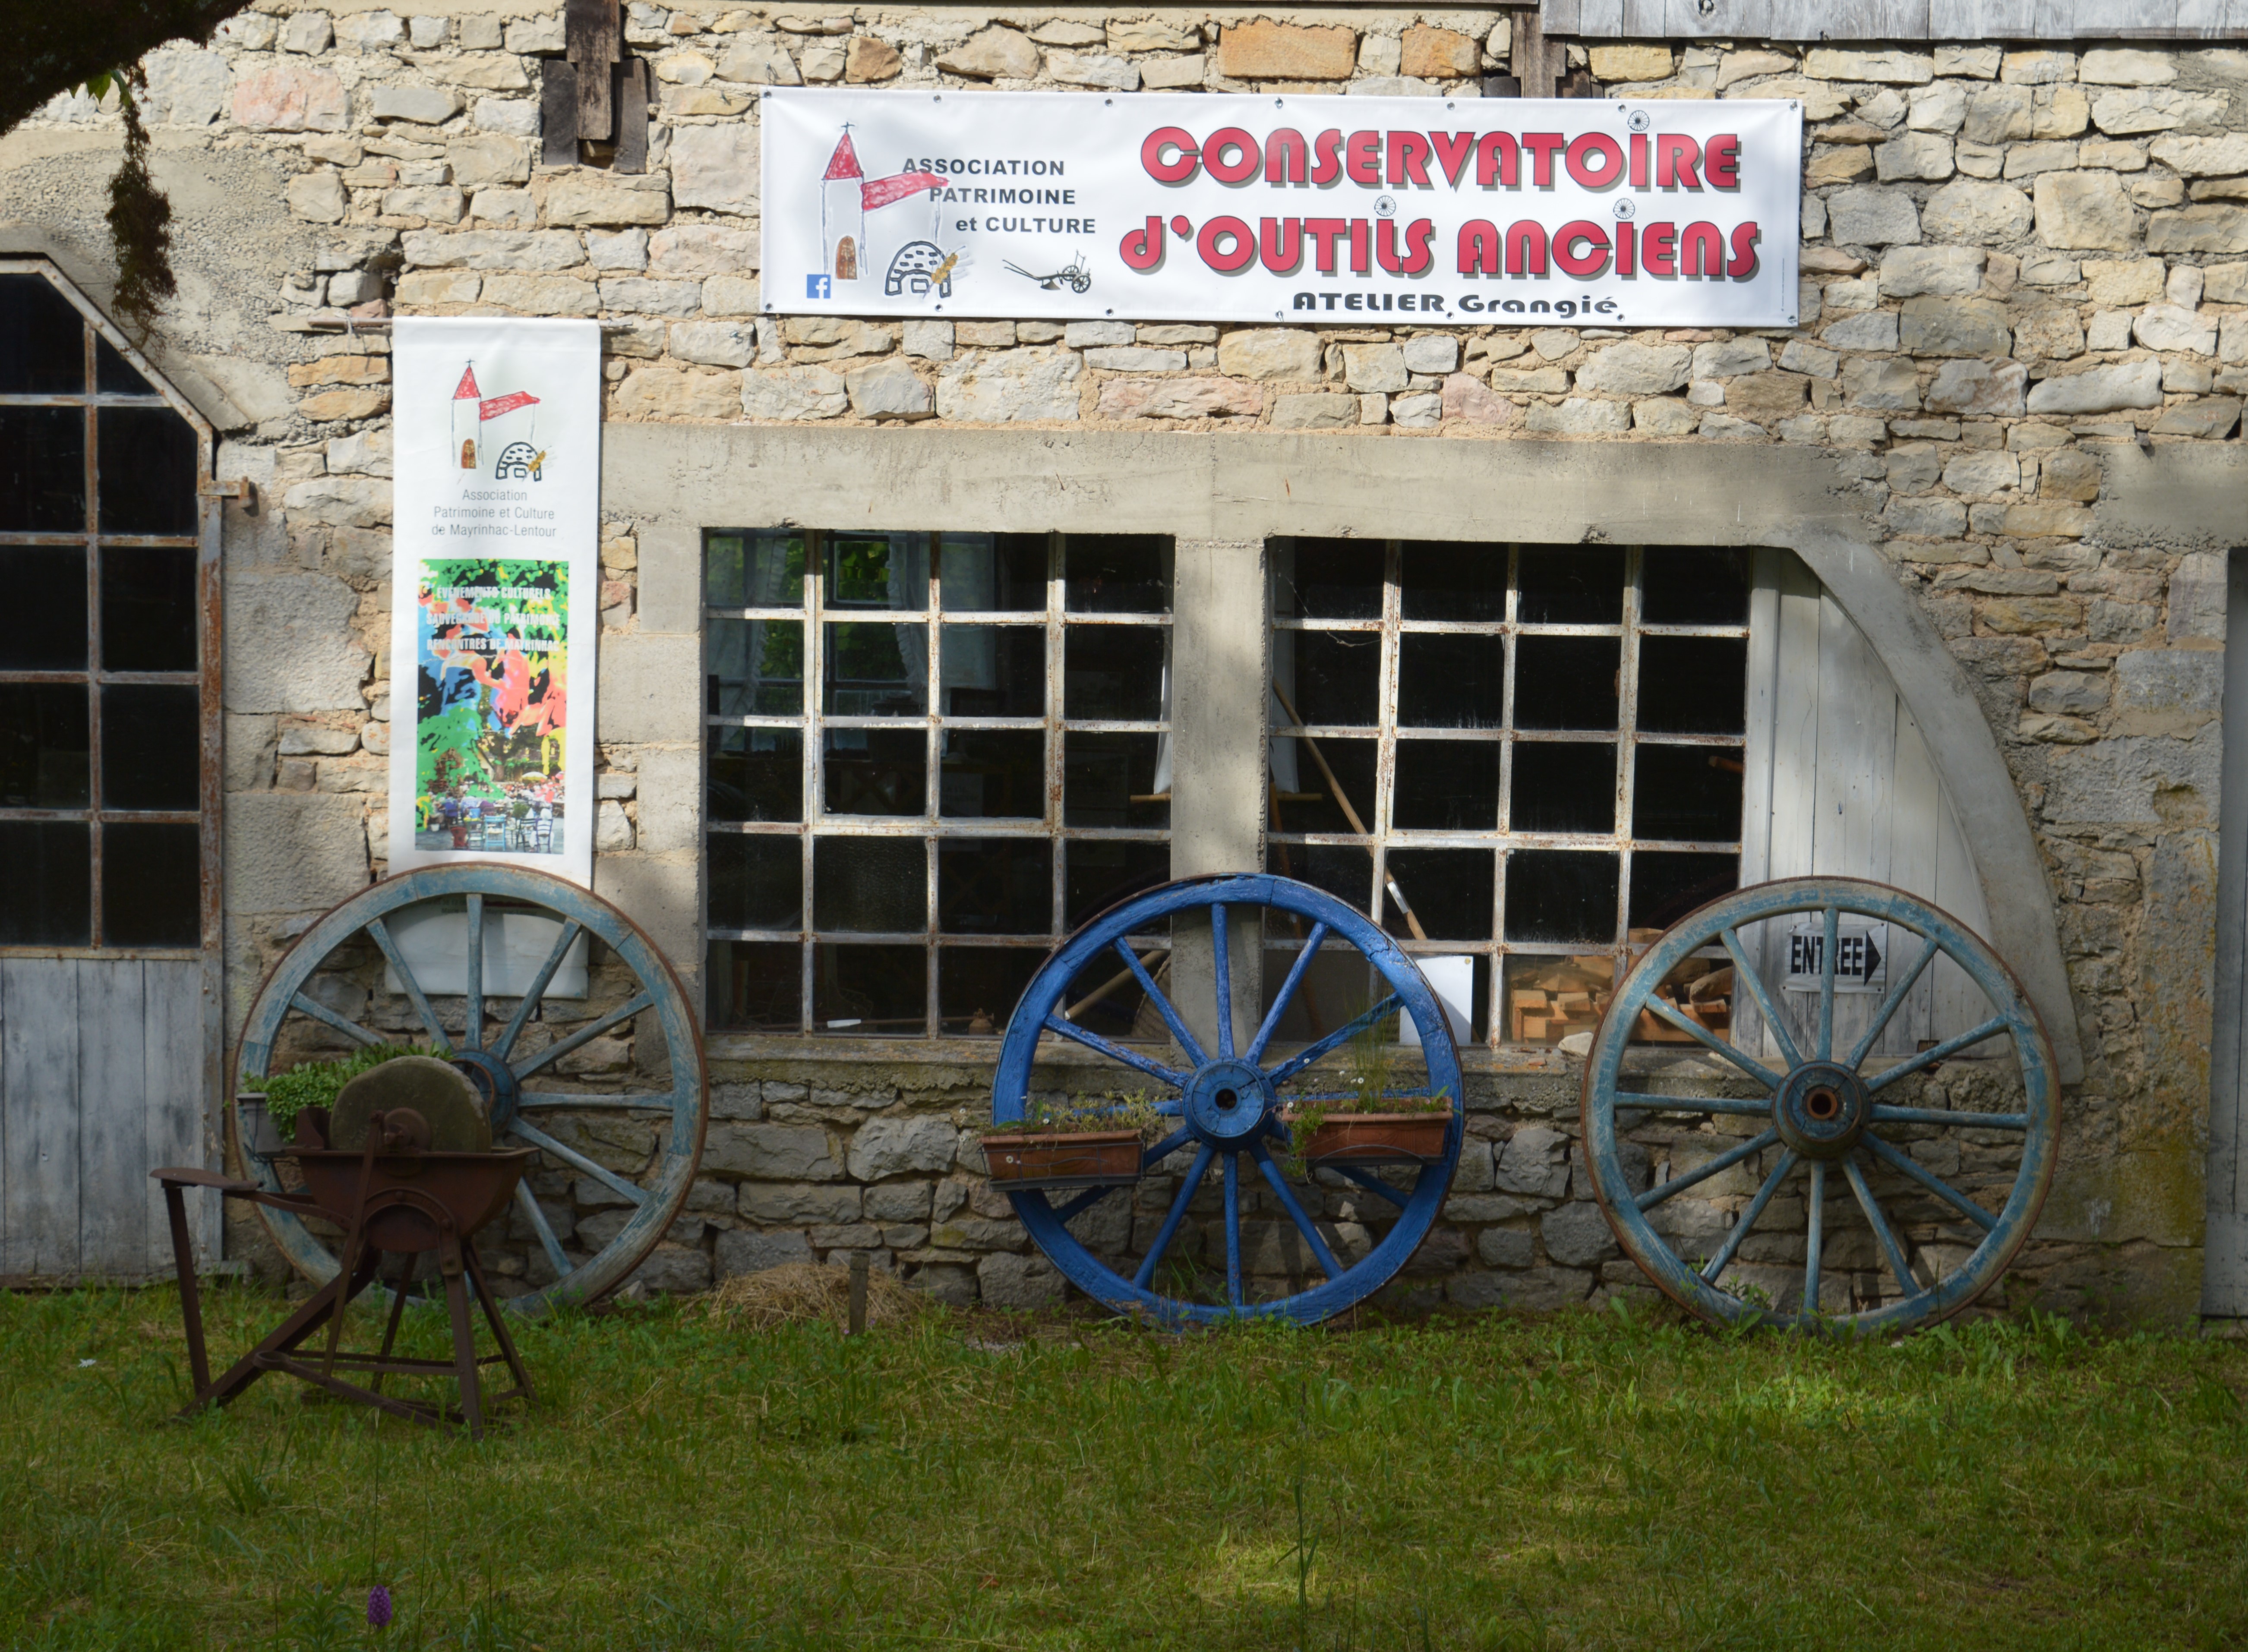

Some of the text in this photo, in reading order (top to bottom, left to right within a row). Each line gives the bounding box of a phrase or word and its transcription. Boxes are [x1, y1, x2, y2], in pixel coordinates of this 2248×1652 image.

[1141, 126, 1740, 188] CONSERVATOIRE
[902, 158, 1065, 176] ASSOCIATION
[929, 187, 1076, 204] PATRIMOINE
[956, 217, 1096, 233] et CULTURE
[1457, 219, 1759, 278] ANCIENS
[1293, 292, 1618, 318] ATELIER Grangié
[462, 489, 527, 501] Association
[434, 506, 554, 519] Patrimoine et Culture
[432, 524, 556, 538] de Mayrinhac-Lentour
[501, 587, 551, 599] CULTURELS
[427, 638, 560, 652] RENCONTRES DE MAYRINHAC
